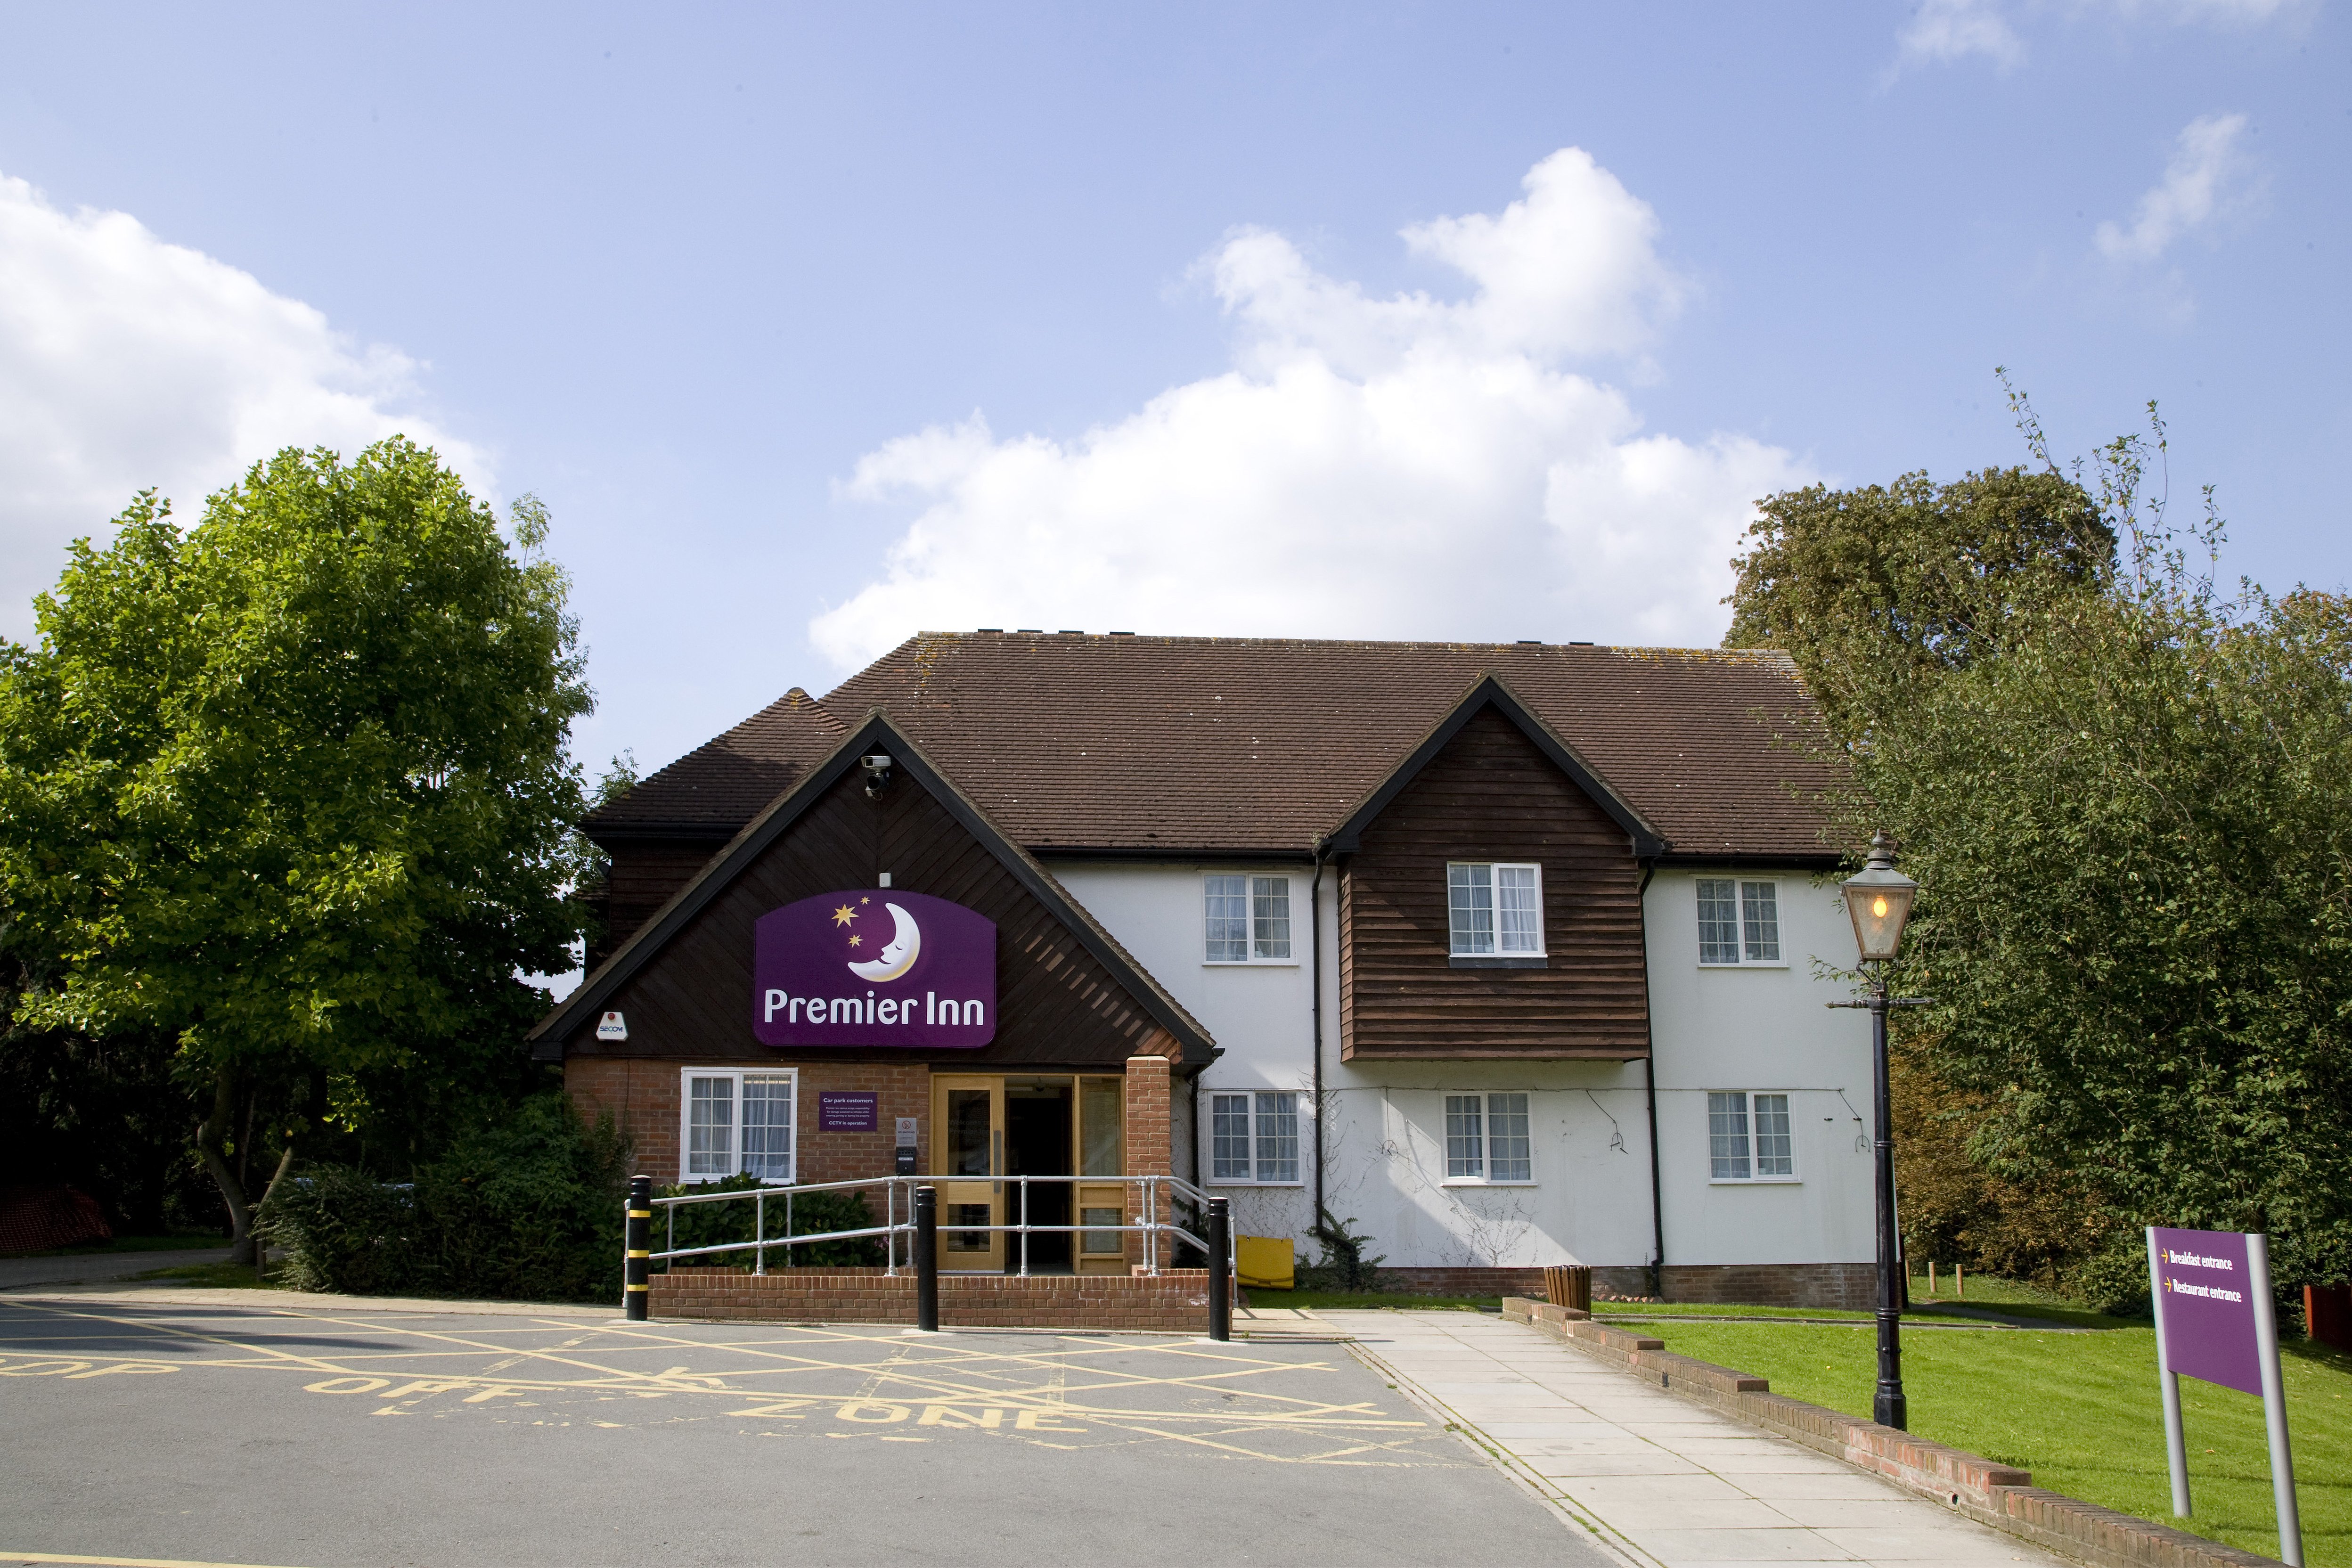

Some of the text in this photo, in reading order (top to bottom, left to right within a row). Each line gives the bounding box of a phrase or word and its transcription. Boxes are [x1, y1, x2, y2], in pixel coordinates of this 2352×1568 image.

[764, 989, 984, 1026] Premier Inn
[2169, 1250, 2233, 1270] Breakfast entrance
[2172, 1278, 2242, 1303] Restaurant entrance
[0, 1359, 1089, 1433] OP OFF ZONE
